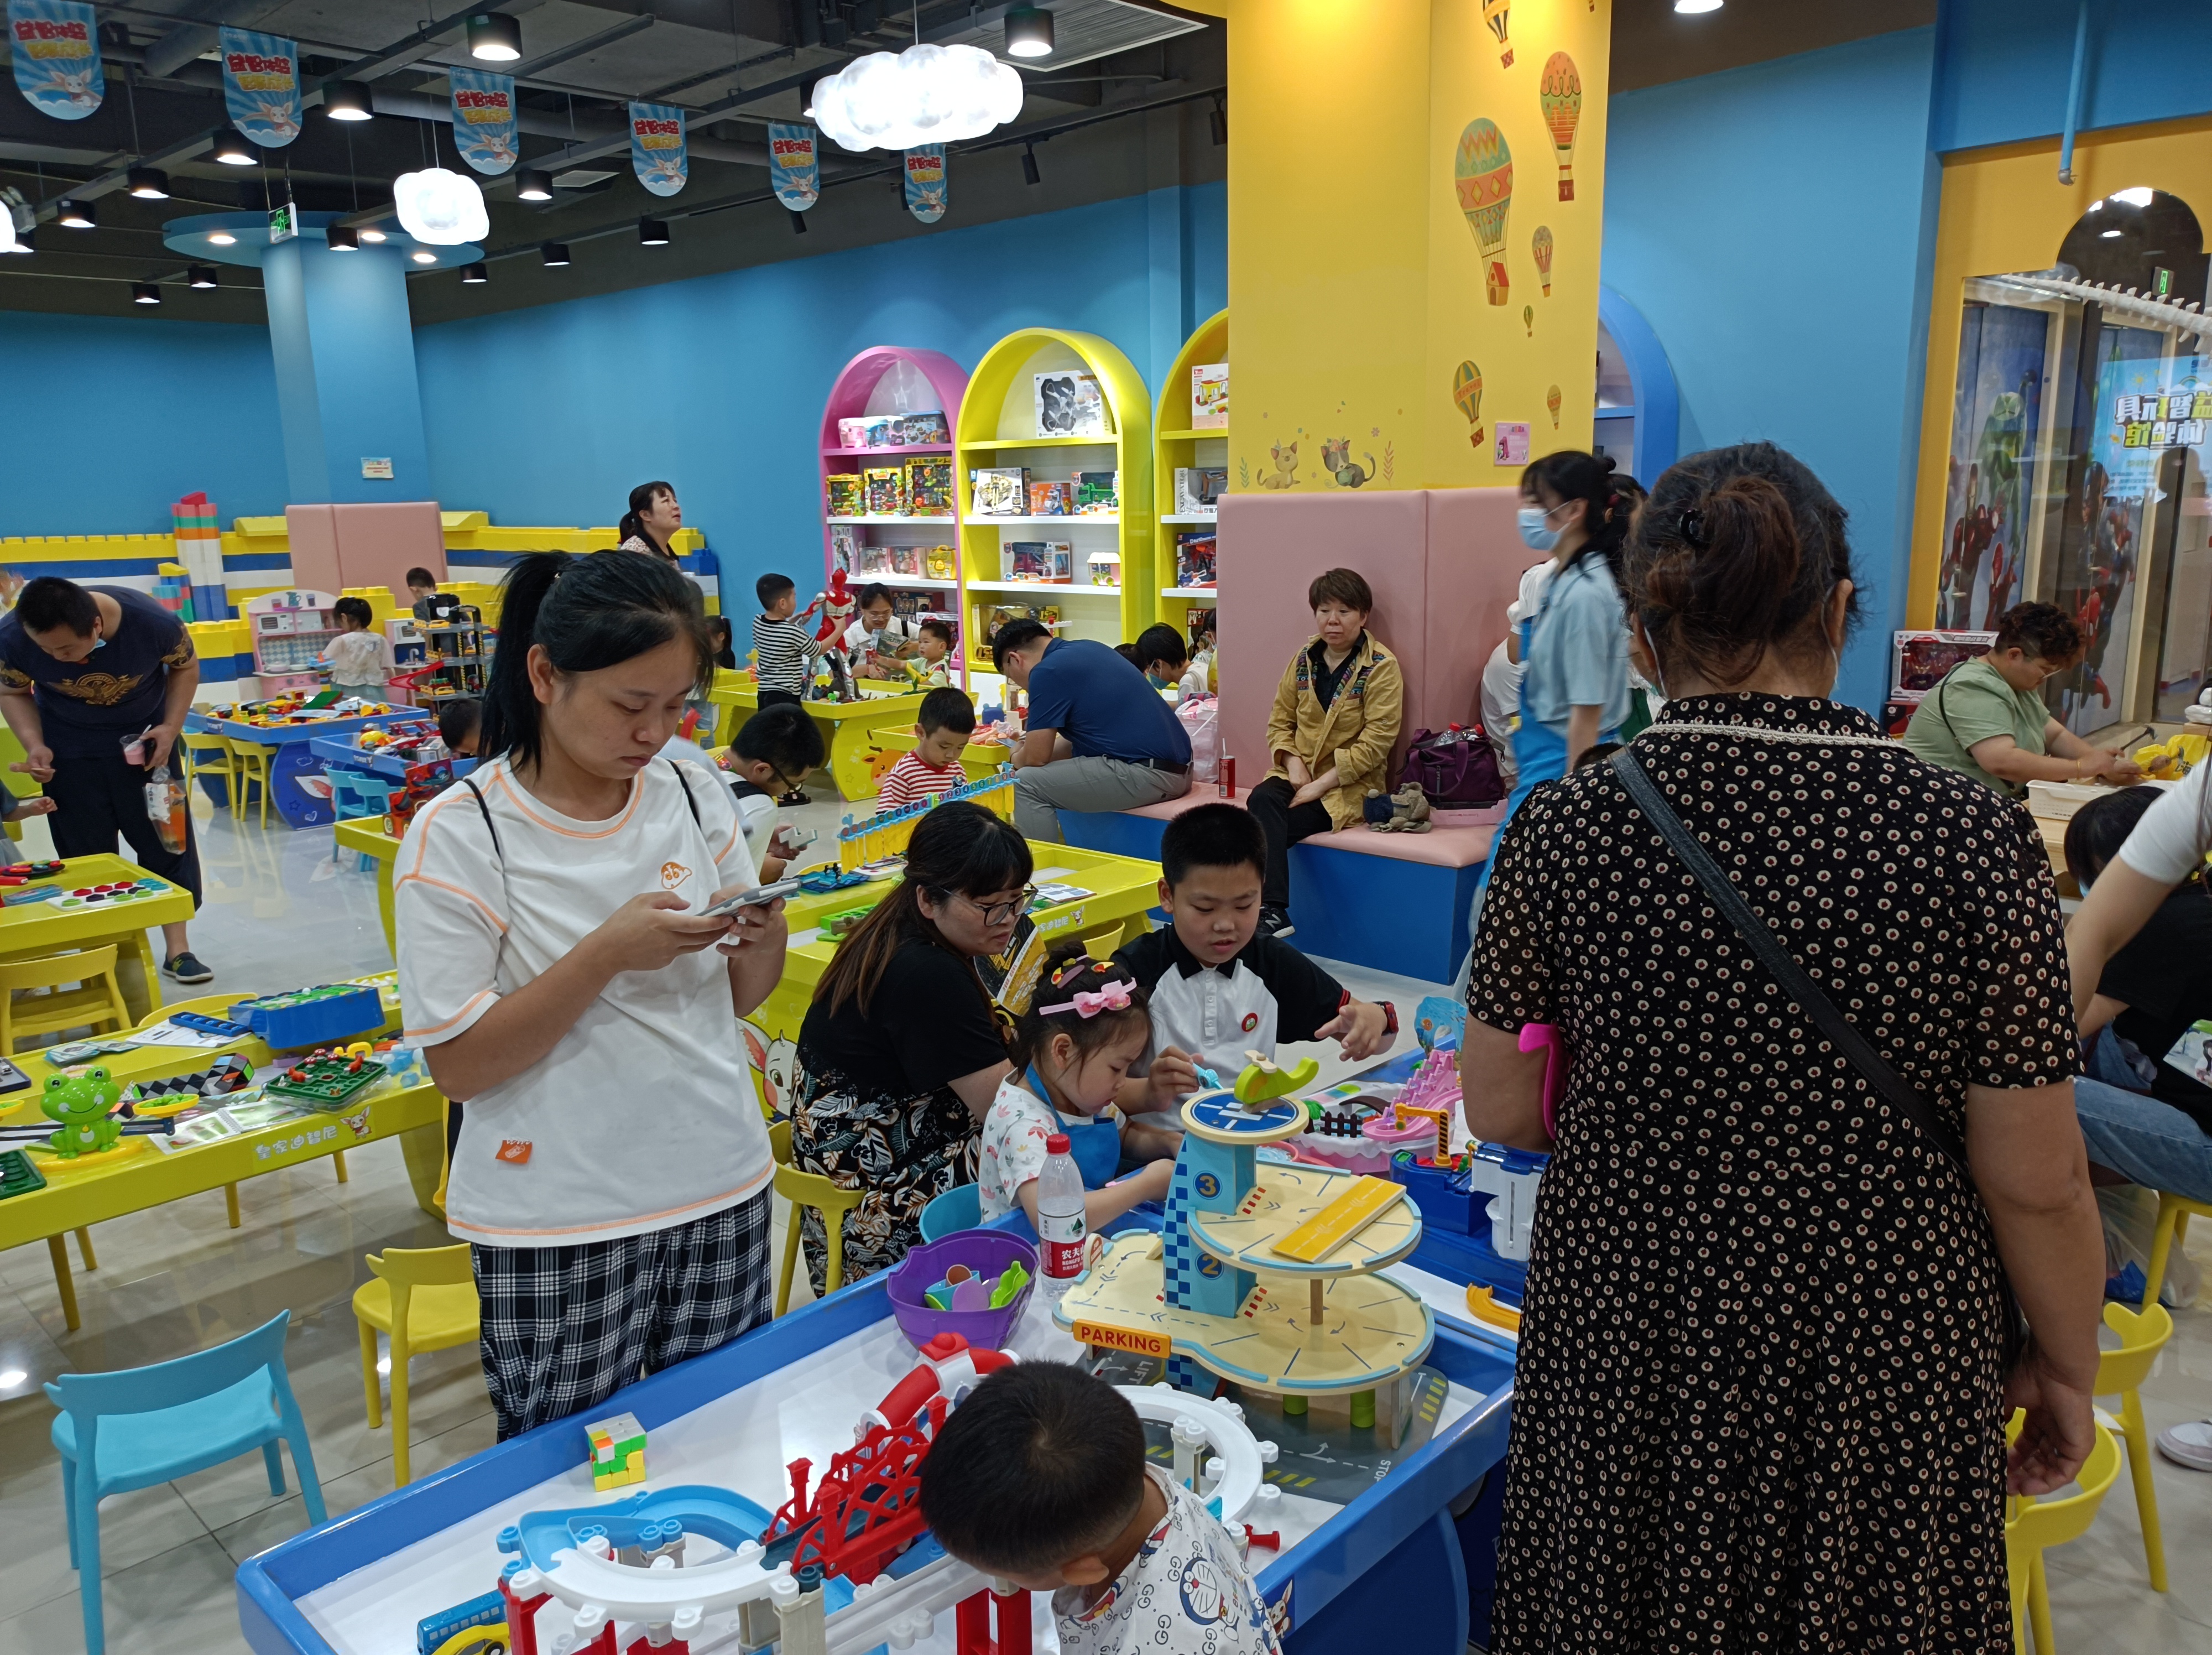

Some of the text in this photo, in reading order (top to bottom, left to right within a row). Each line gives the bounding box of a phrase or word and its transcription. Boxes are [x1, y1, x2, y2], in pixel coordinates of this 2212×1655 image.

[254, 1125, 338, 1160] 皇家迪智尼
[1199, 1174, 1217, 1195] 3
[1062, 1257, 1081, 1266] NONGFU
[1202, 1254, 1219, 1275] 2
[1081, 1326, 1161, 1353] PARKING
[1129, 1361, 1154, 1385] LIFT
